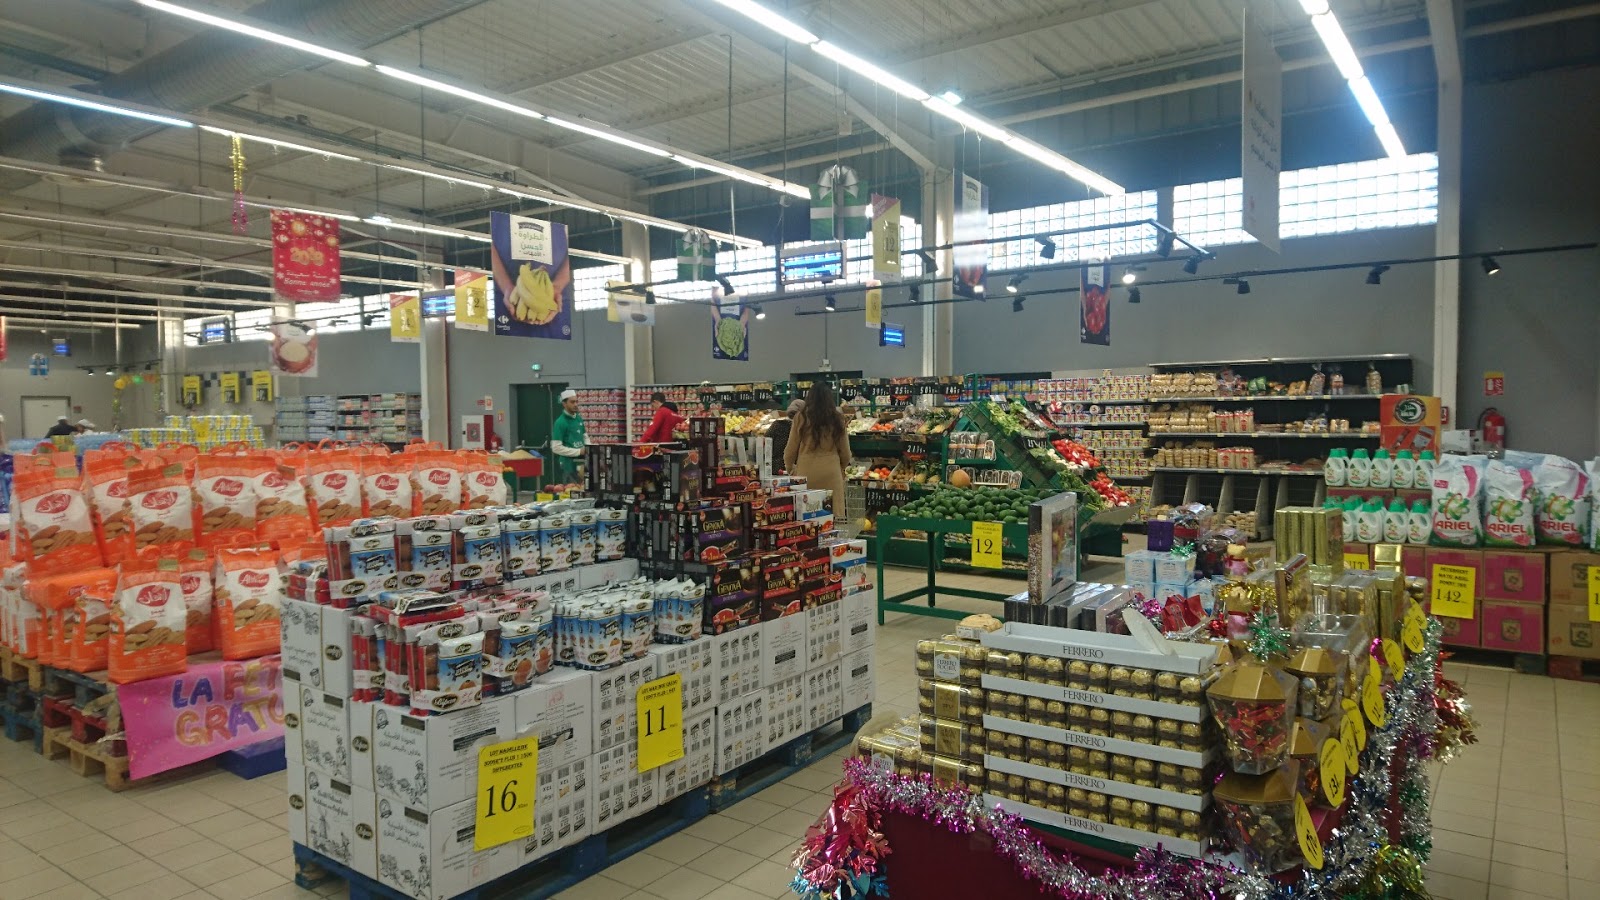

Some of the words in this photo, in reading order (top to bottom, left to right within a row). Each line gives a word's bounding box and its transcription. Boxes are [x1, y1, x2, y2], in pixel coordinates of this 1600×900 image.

[1435, 521, 1474, 530] ARIEL
[1487, 523, 1527, 533] ARIEL
[1541, 520, 1578, 531] ARIEL
[975, 538, 993, 555] 12
[1435, 588, 1462, 603] 142
[1062, 645, 1105, 659] FERRERO
[937, 659, 957, 667] FERRERO
[937, 664, 957, 672] ROCHER
[171, 676, 213, 708] LA
[1062, 689, 1105, 705] FERRERO
[644, 704, 667, 738] 11
[1064, 732, 1107, 748] FERRERO
[1064, 773, 1106, 790] FERRERO
[485, 779, 518, 818] 16
[1063, 816, 1105, 834] FERRERO
